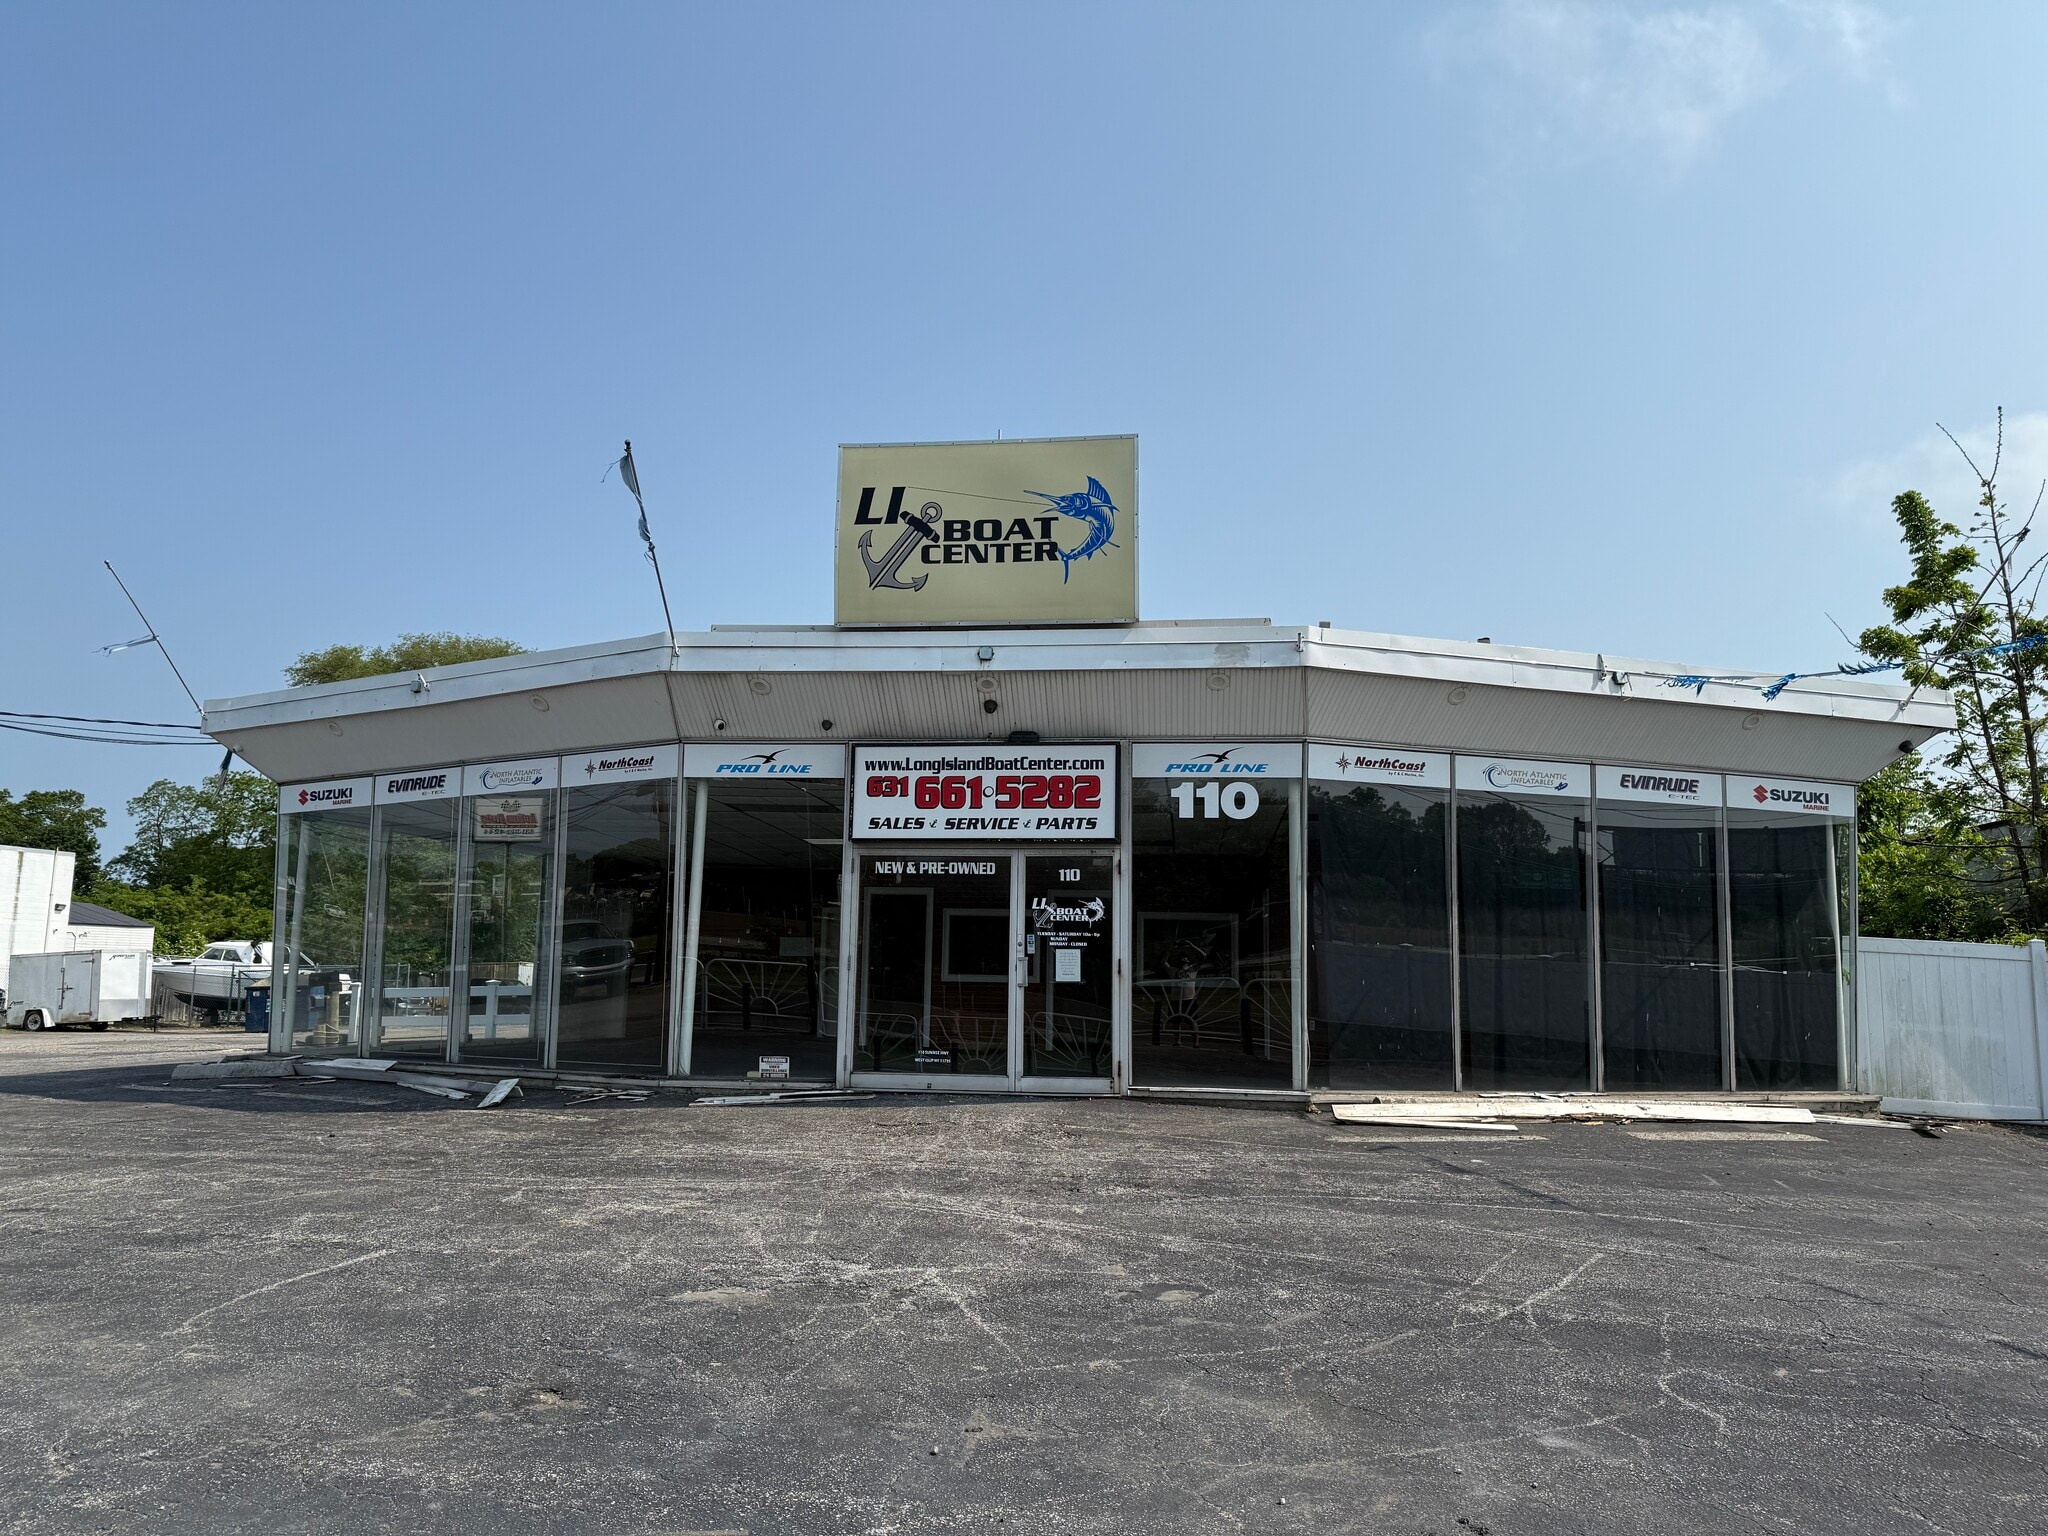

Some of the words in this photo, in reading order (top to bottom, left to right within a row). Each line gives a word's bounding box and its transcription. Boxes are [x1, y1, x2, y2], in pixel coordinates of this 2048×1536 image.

[854, 486, 906, 525] LI
[943, 516, 1060, 542] BOAT
[920, 541, 1058, 564] CENTER
[598, 755, 654, 770] NorthCoast
[716, 764, 758, 773] PRO
[768, 764, 812, 773] LINE
[864, 756, 1105, 775] www.LongIslandBoatCenter.com
[1165, 763, 1211, 773] PRO
[1220, 763, 1269, 773] LINE
[1354, 756, 1426, 771] NorthCoast
[866, 776, 909, 798] 631
[310, 788, 353, 801] SUZUKI
[1171, 782, 1260, 819] 110
[1769, 789, 1830, 805] SUZUKI
[1802, 804, 1830, 812] MARINE
[868, 817, 925, 830] SALES
[944, 817, 1018, 830] SERVICE
[1036, 817, 1098, 830] PARTS
[875, 861, 904, 874] NEW
[906, 862, 917, 874] &
[919, 862, 996, 875] PRE-OWNED
[1058, 868, 1081, 882] 110
[1032, 898, 1047, 910] LI
[1056, 907, 1089, 915] BOAT
[1050, 914, 1089, 922] CENTER
